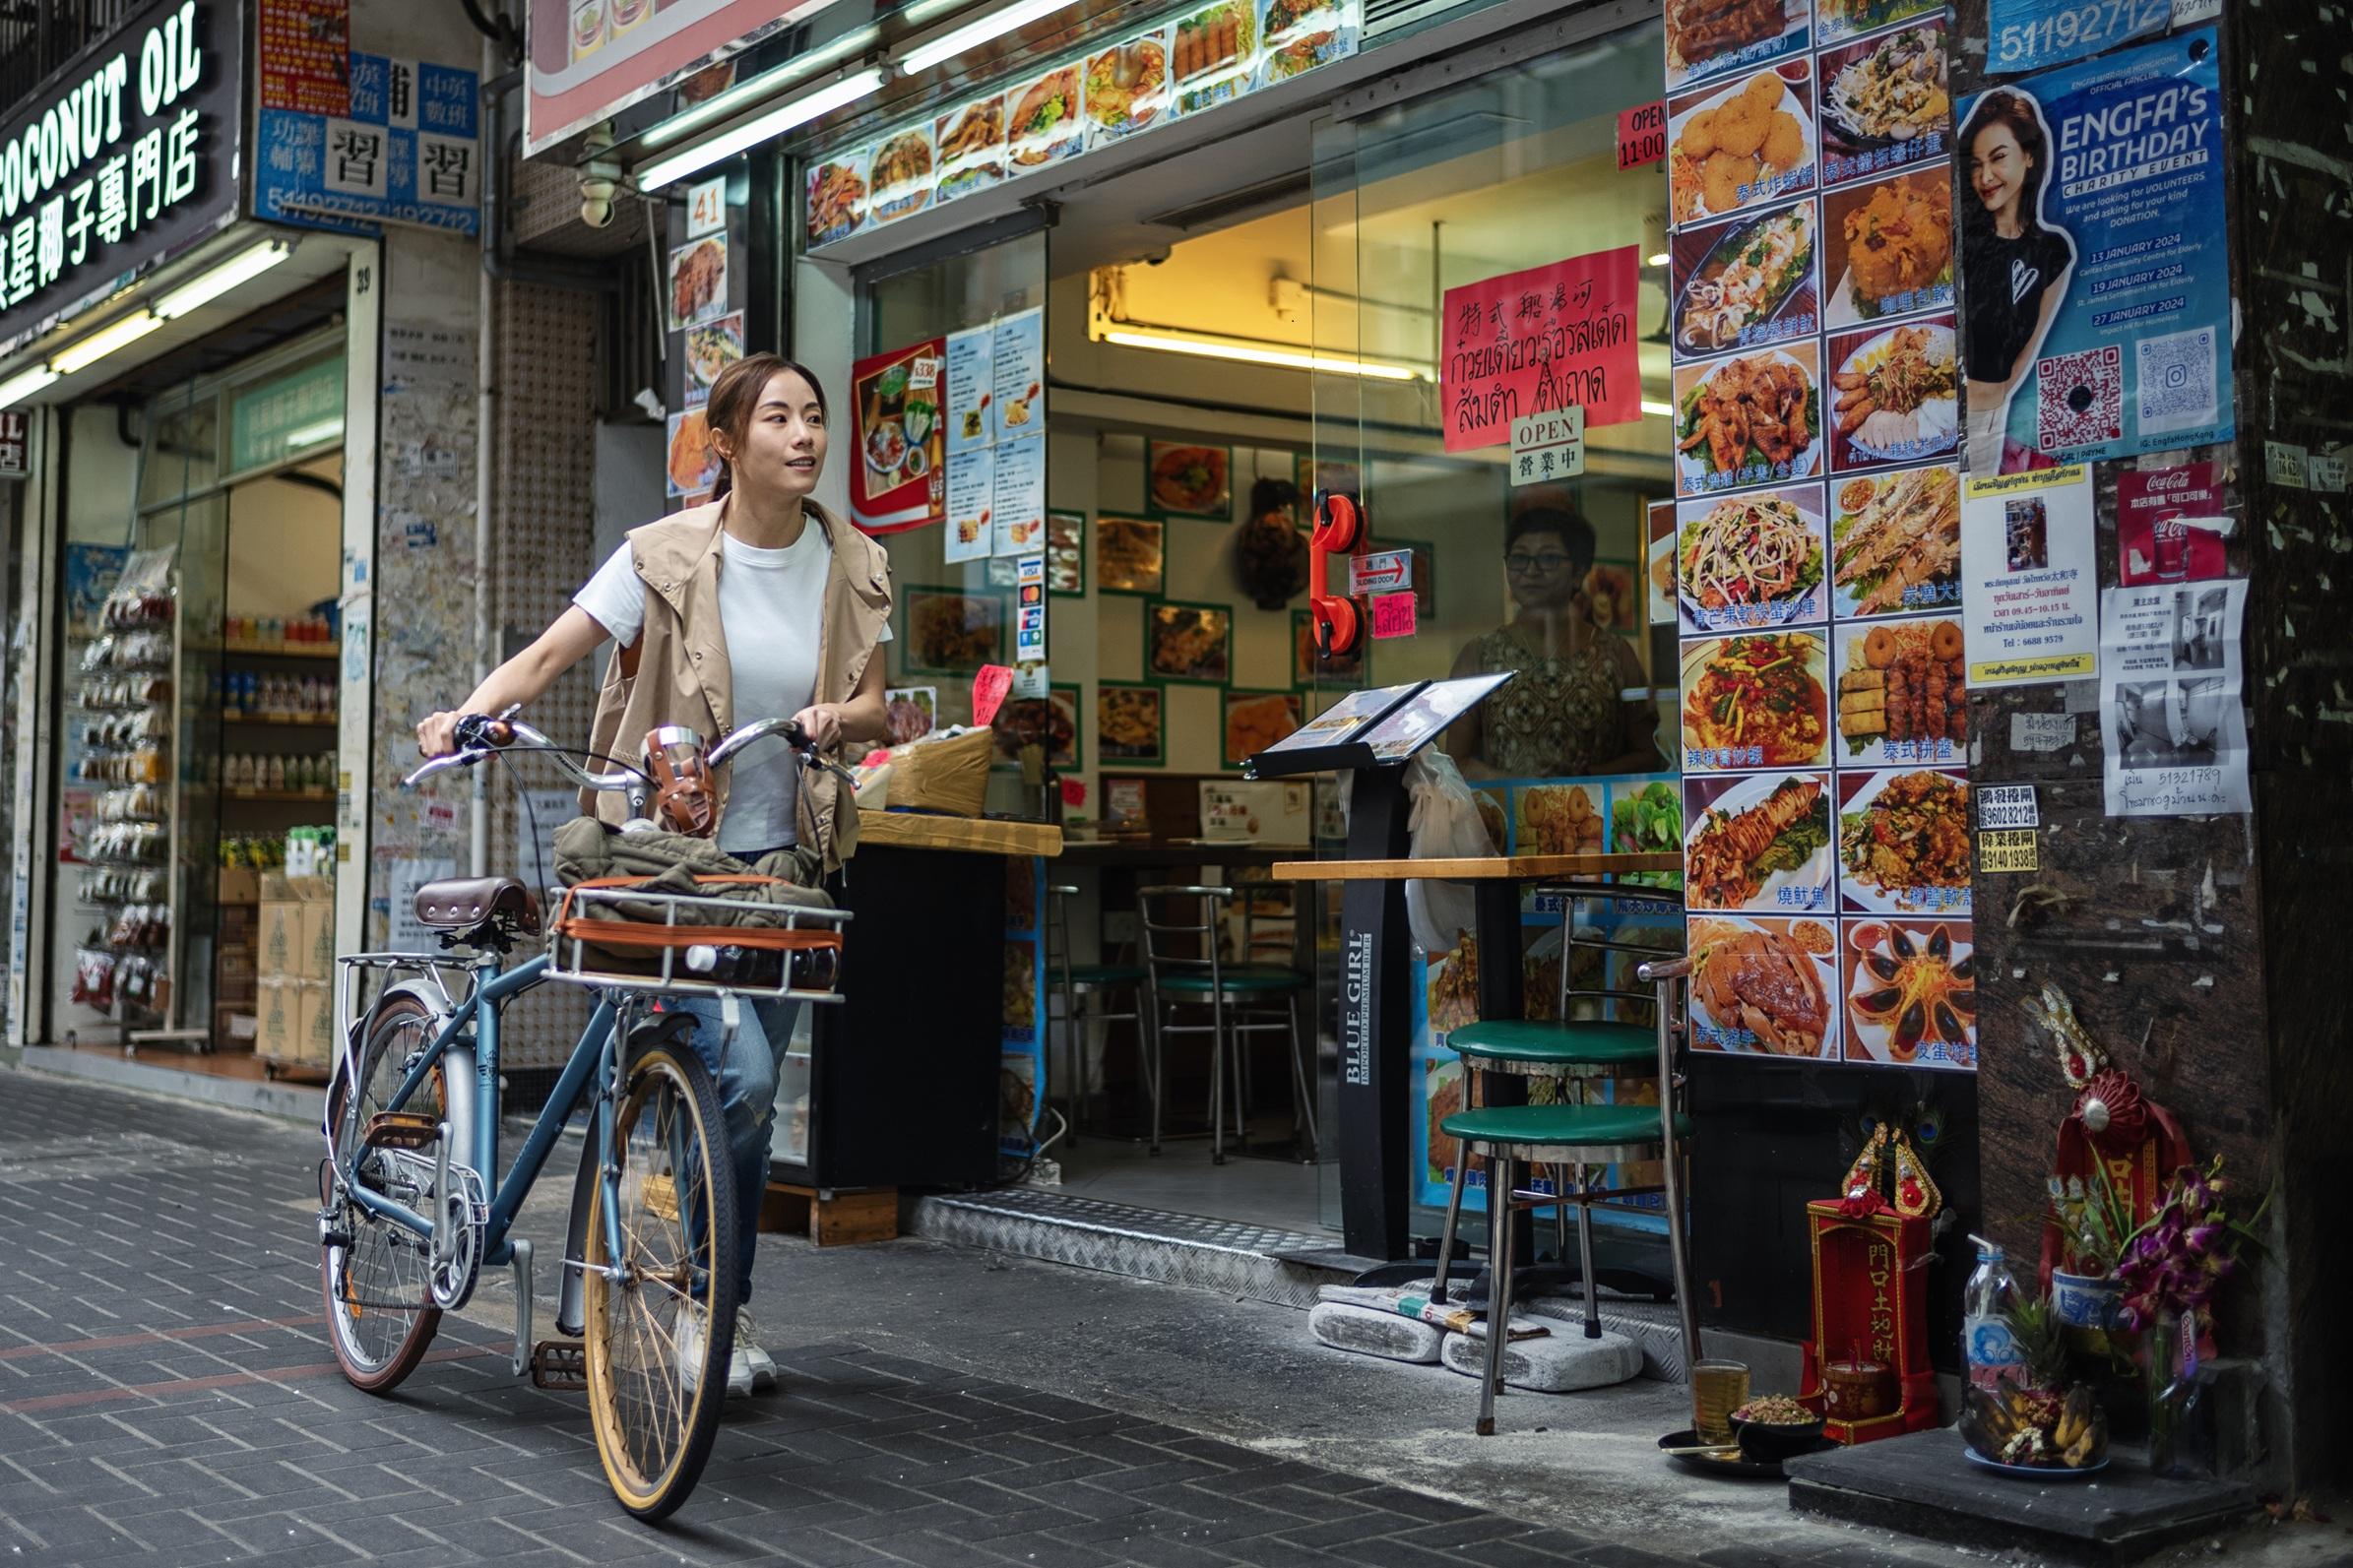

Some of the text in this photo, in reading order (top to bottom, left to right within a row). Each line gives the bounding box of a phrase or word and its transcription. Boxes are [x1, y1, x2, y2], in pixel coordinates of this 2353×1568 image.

[2090, 81, 2124, 95] OFFICIAL
[0, 52, 127, 220] OCONUT
[140, 0, 202, 117] OIL
[1622, 132, 1666, 166] 11:00
[2062, 118, 2210, 182] BIRTHDAY
[2064, 150, 2206, 197] CHARITY EVENT
[693, 190, 719, 225] 41
[2066, 171, 2206, 215] We are looking for VOLUNTEERS
[2083, 188, 2189, 222] and asking for your kind
[2091, 232, 2182, 264] 13 JANUARY 2024
[2167, 248, 2177, 257] for
[2178, 243, 2202, 255] Elderly
[2092, 264, 2183, 293] 19 JANUARY 2024
[2159, 280, 2169, 288] for
[2170, 275, 2195, 286] Elderly
[2093, 296, 2185, 326] 27 JANUARY 2024
[1519, 415, 1575, 446] OPEN
[1519, 448, 1576, 478] 營業中
[1356, 575, 1394, 587] SLIDING DOOR
[2003, 638, 2015, 648] Tel
[1882, 739, 1954, 760] 泰式拼盤
[1987, 805, 2029, 825] 9602 8212
[1988, 849, 2029, 869] 9140 1938
[1777, 886, 1826, 906] 燒魷魚
[1346, 932, 1364, 1085] BLUE GIRL
[1361, 935, 1371, 1085] IMPORTED PREMIUM BEER
